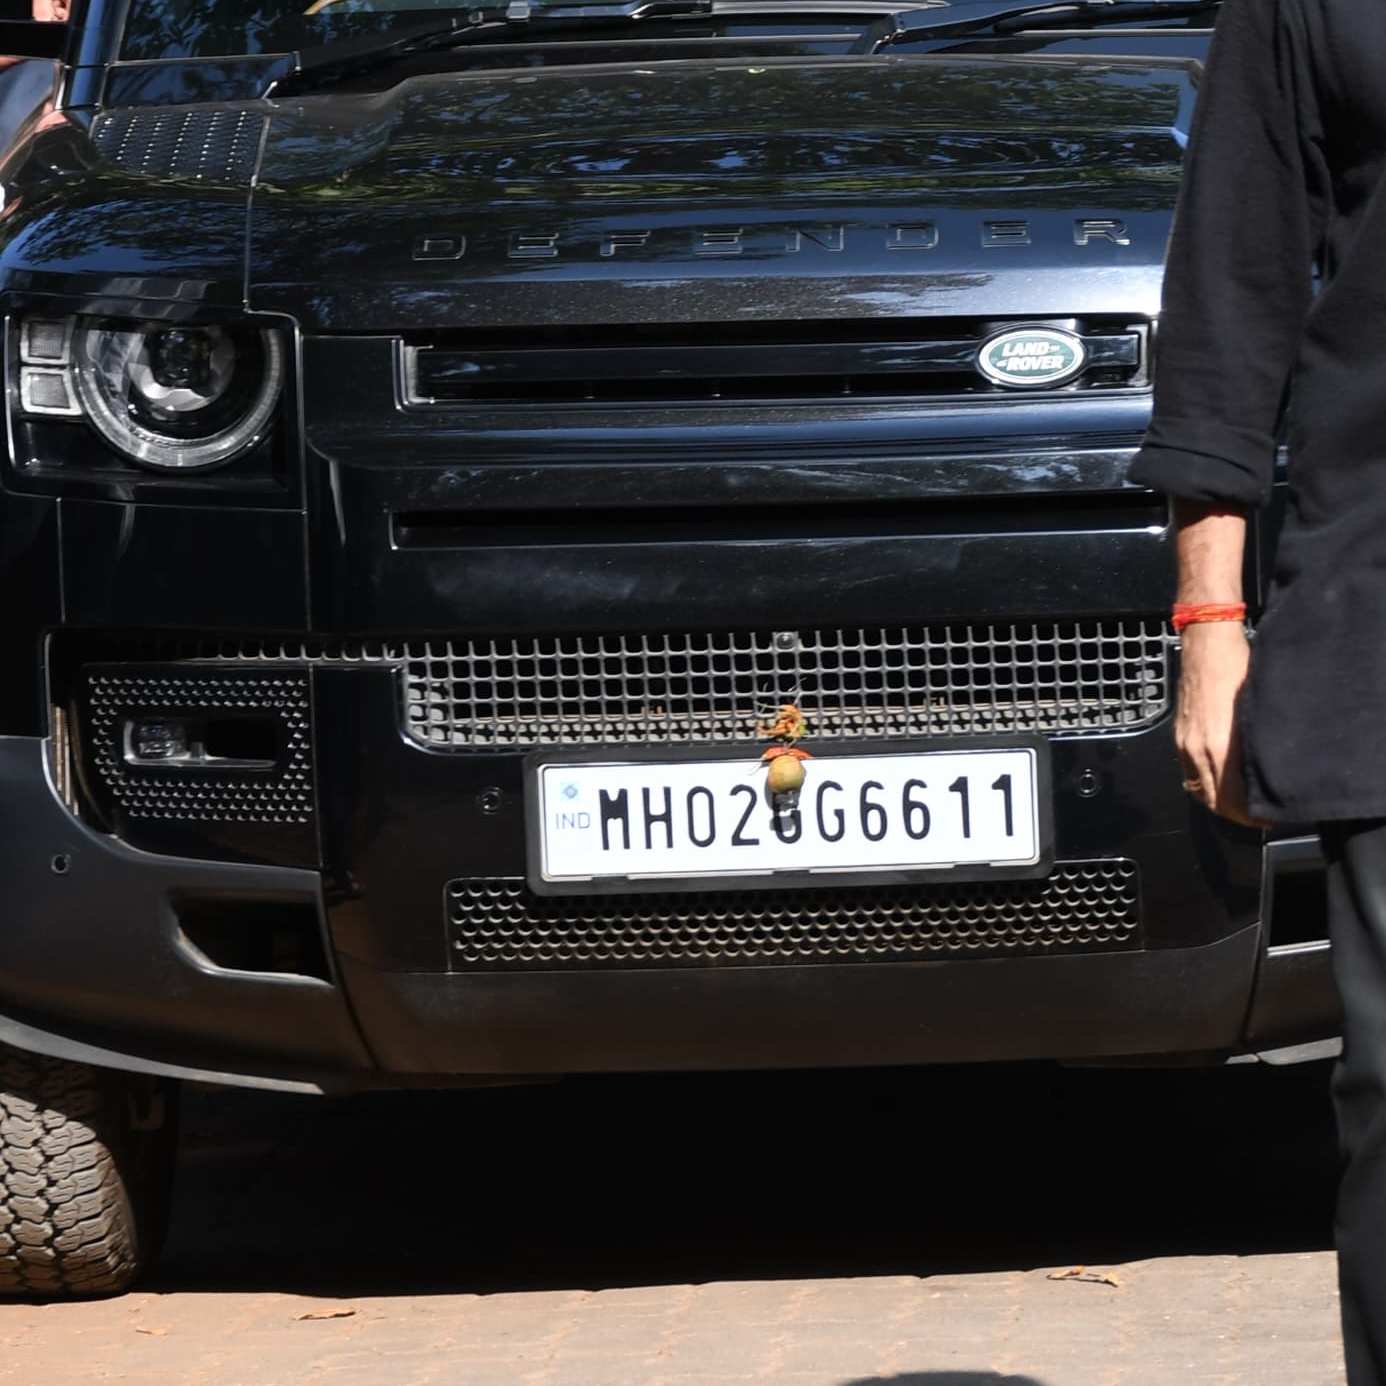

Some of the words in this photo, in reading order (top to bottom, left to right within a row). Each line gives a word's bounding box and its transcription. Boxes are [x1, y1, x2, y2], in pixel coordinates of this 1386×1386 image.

[411, 219, 1131, 261] DEFENDER
[1001, 341, 1049, 356] LAND
[1006, 355, 1064, 371] ROVER
[555, 812, 591, 830] IND
